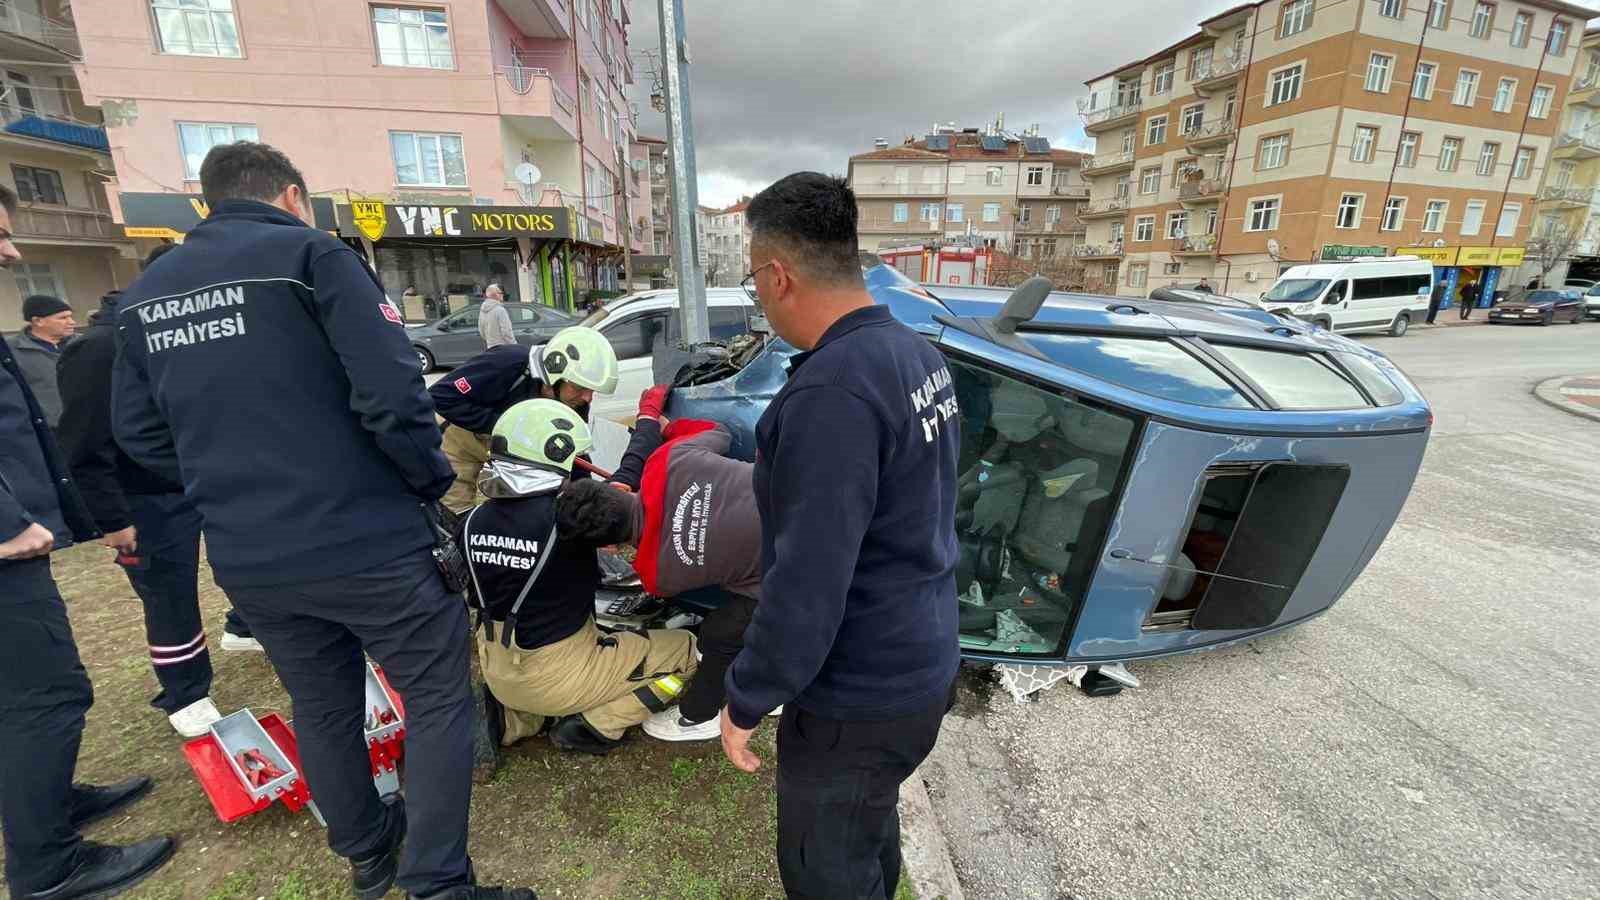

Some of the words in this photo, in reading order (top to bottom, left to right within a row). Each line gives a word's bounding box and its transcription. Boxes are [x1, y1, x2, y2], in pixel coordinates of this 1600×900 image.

[395, 206, 460, 236] YNC
[472, 213, 554, 231] MOTORS
[138, 286, 245, 325] KARAMAN
[146, 312, 246, 353] İTFAİYESİ
[672, 482, 700, 532] ÜNİVERSİTESİ
[692, 499, 701, 518] MYO
[470, 534, 538, 553] KARAMAN
[673, 534, 693, 566] GİRESUN
[688, 520, 699, 551] ESPİYE
[471, 548, 536, 570] İTFAİYESİ
